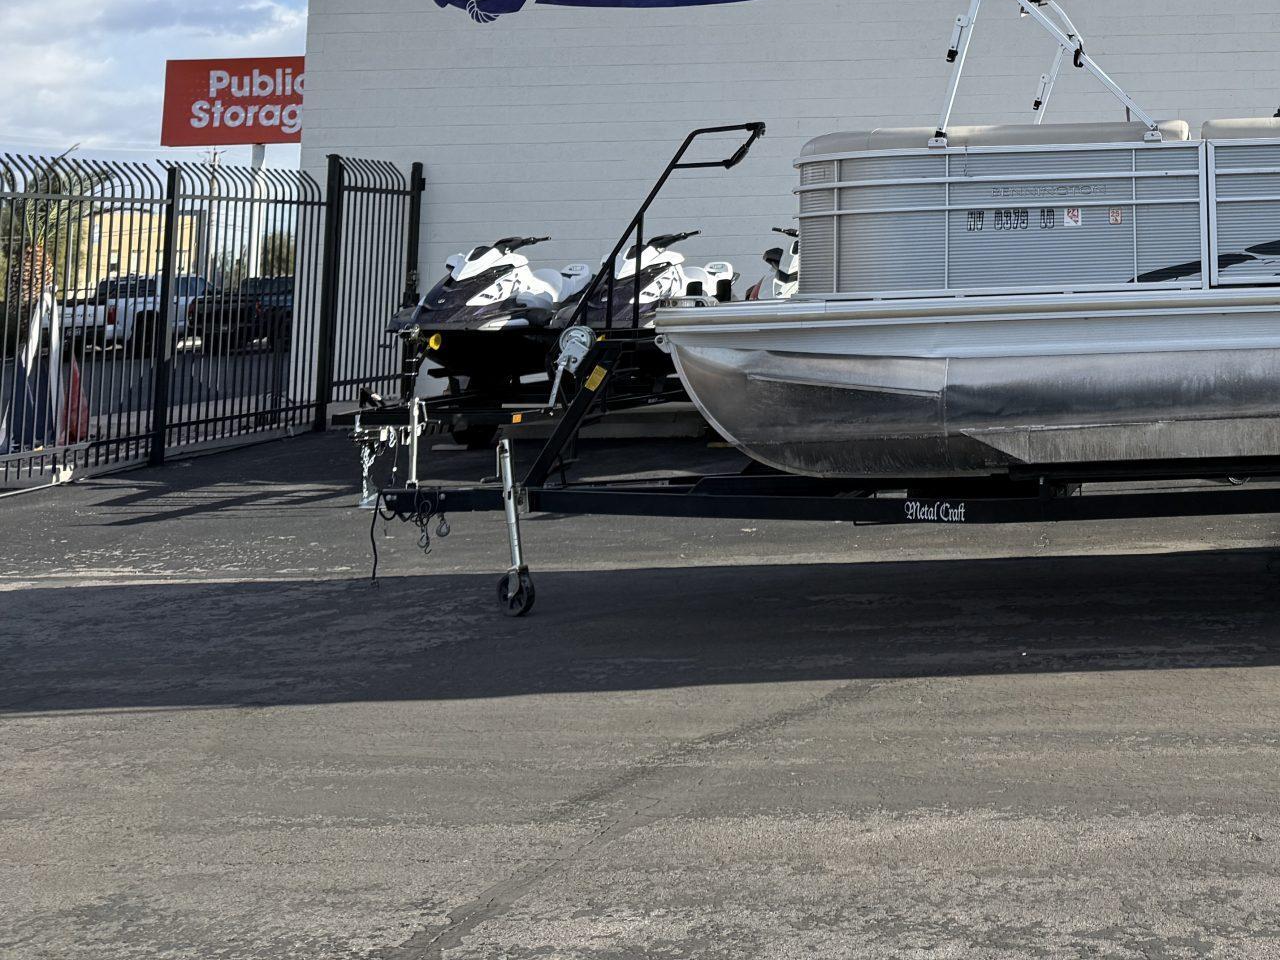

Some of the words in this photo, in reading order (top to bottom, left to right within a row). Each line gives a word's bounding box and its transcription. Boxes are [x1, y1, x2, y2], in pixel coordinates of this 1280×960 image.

[190, 100, 302, 134] Storag
[904, 501, 940, 520] Metal
[940, 502, 965, 521] Craft
